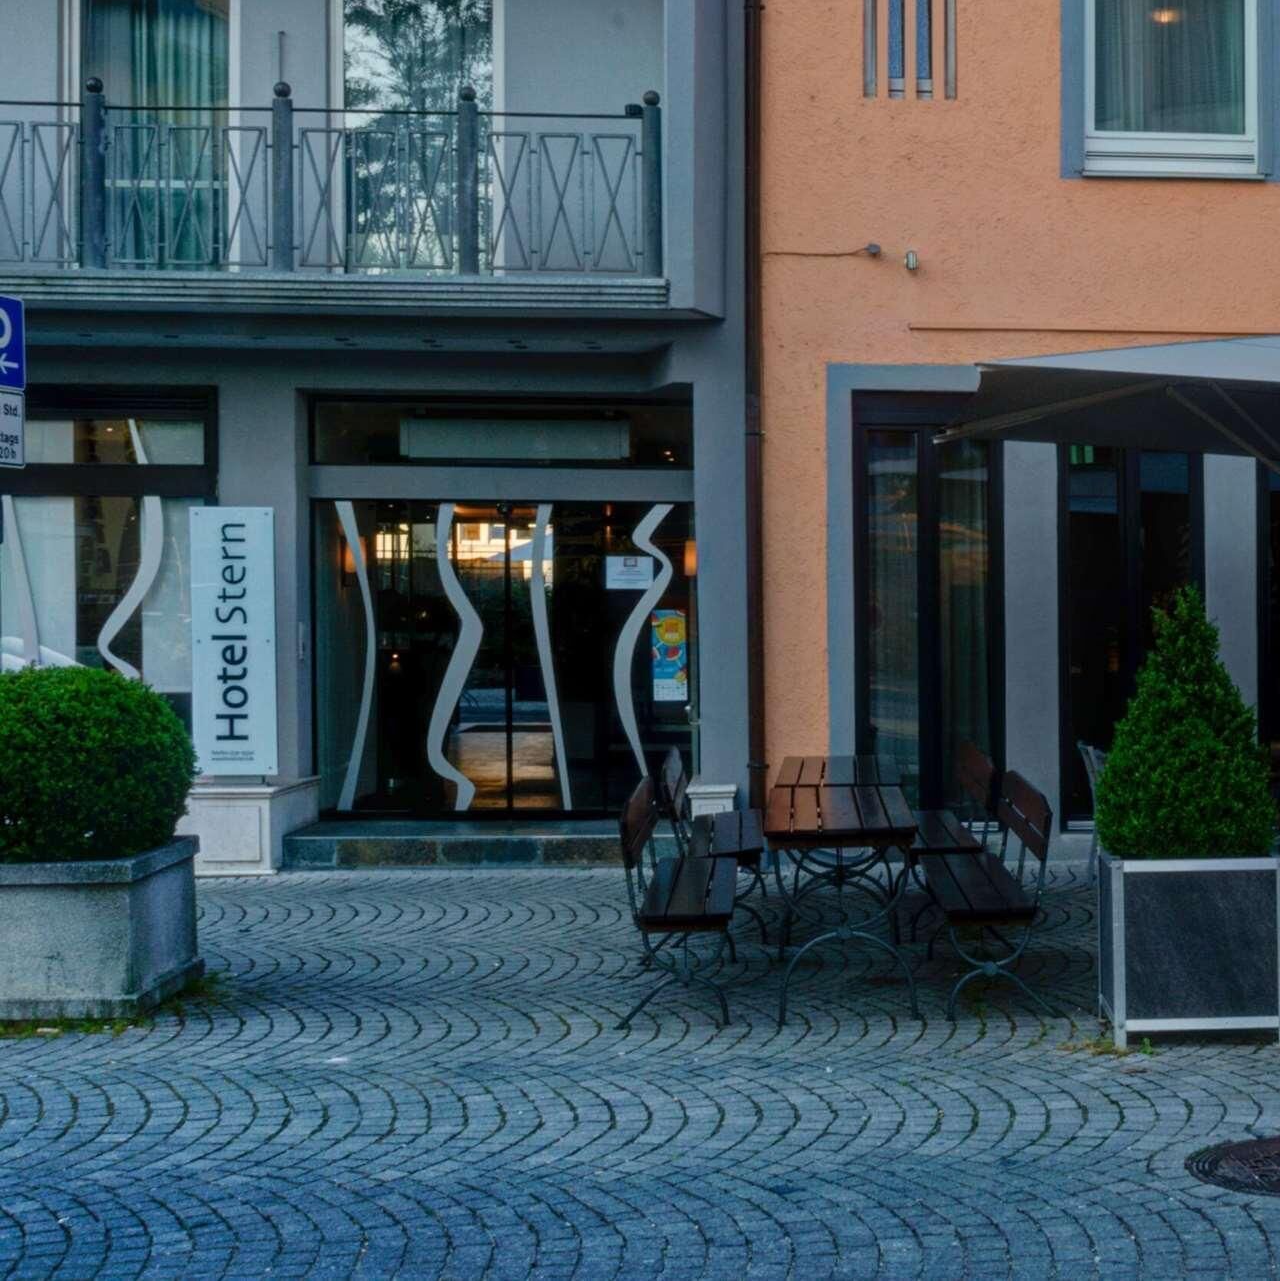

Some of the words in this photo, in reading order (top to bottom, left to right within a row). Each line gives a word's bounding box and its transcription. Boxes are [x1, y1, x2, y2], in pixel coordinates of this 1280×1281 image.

[0, 432, 19, 447] tags
[215, 522, 248, 624] Stern
[211, 635, 249, 741] Hotel
